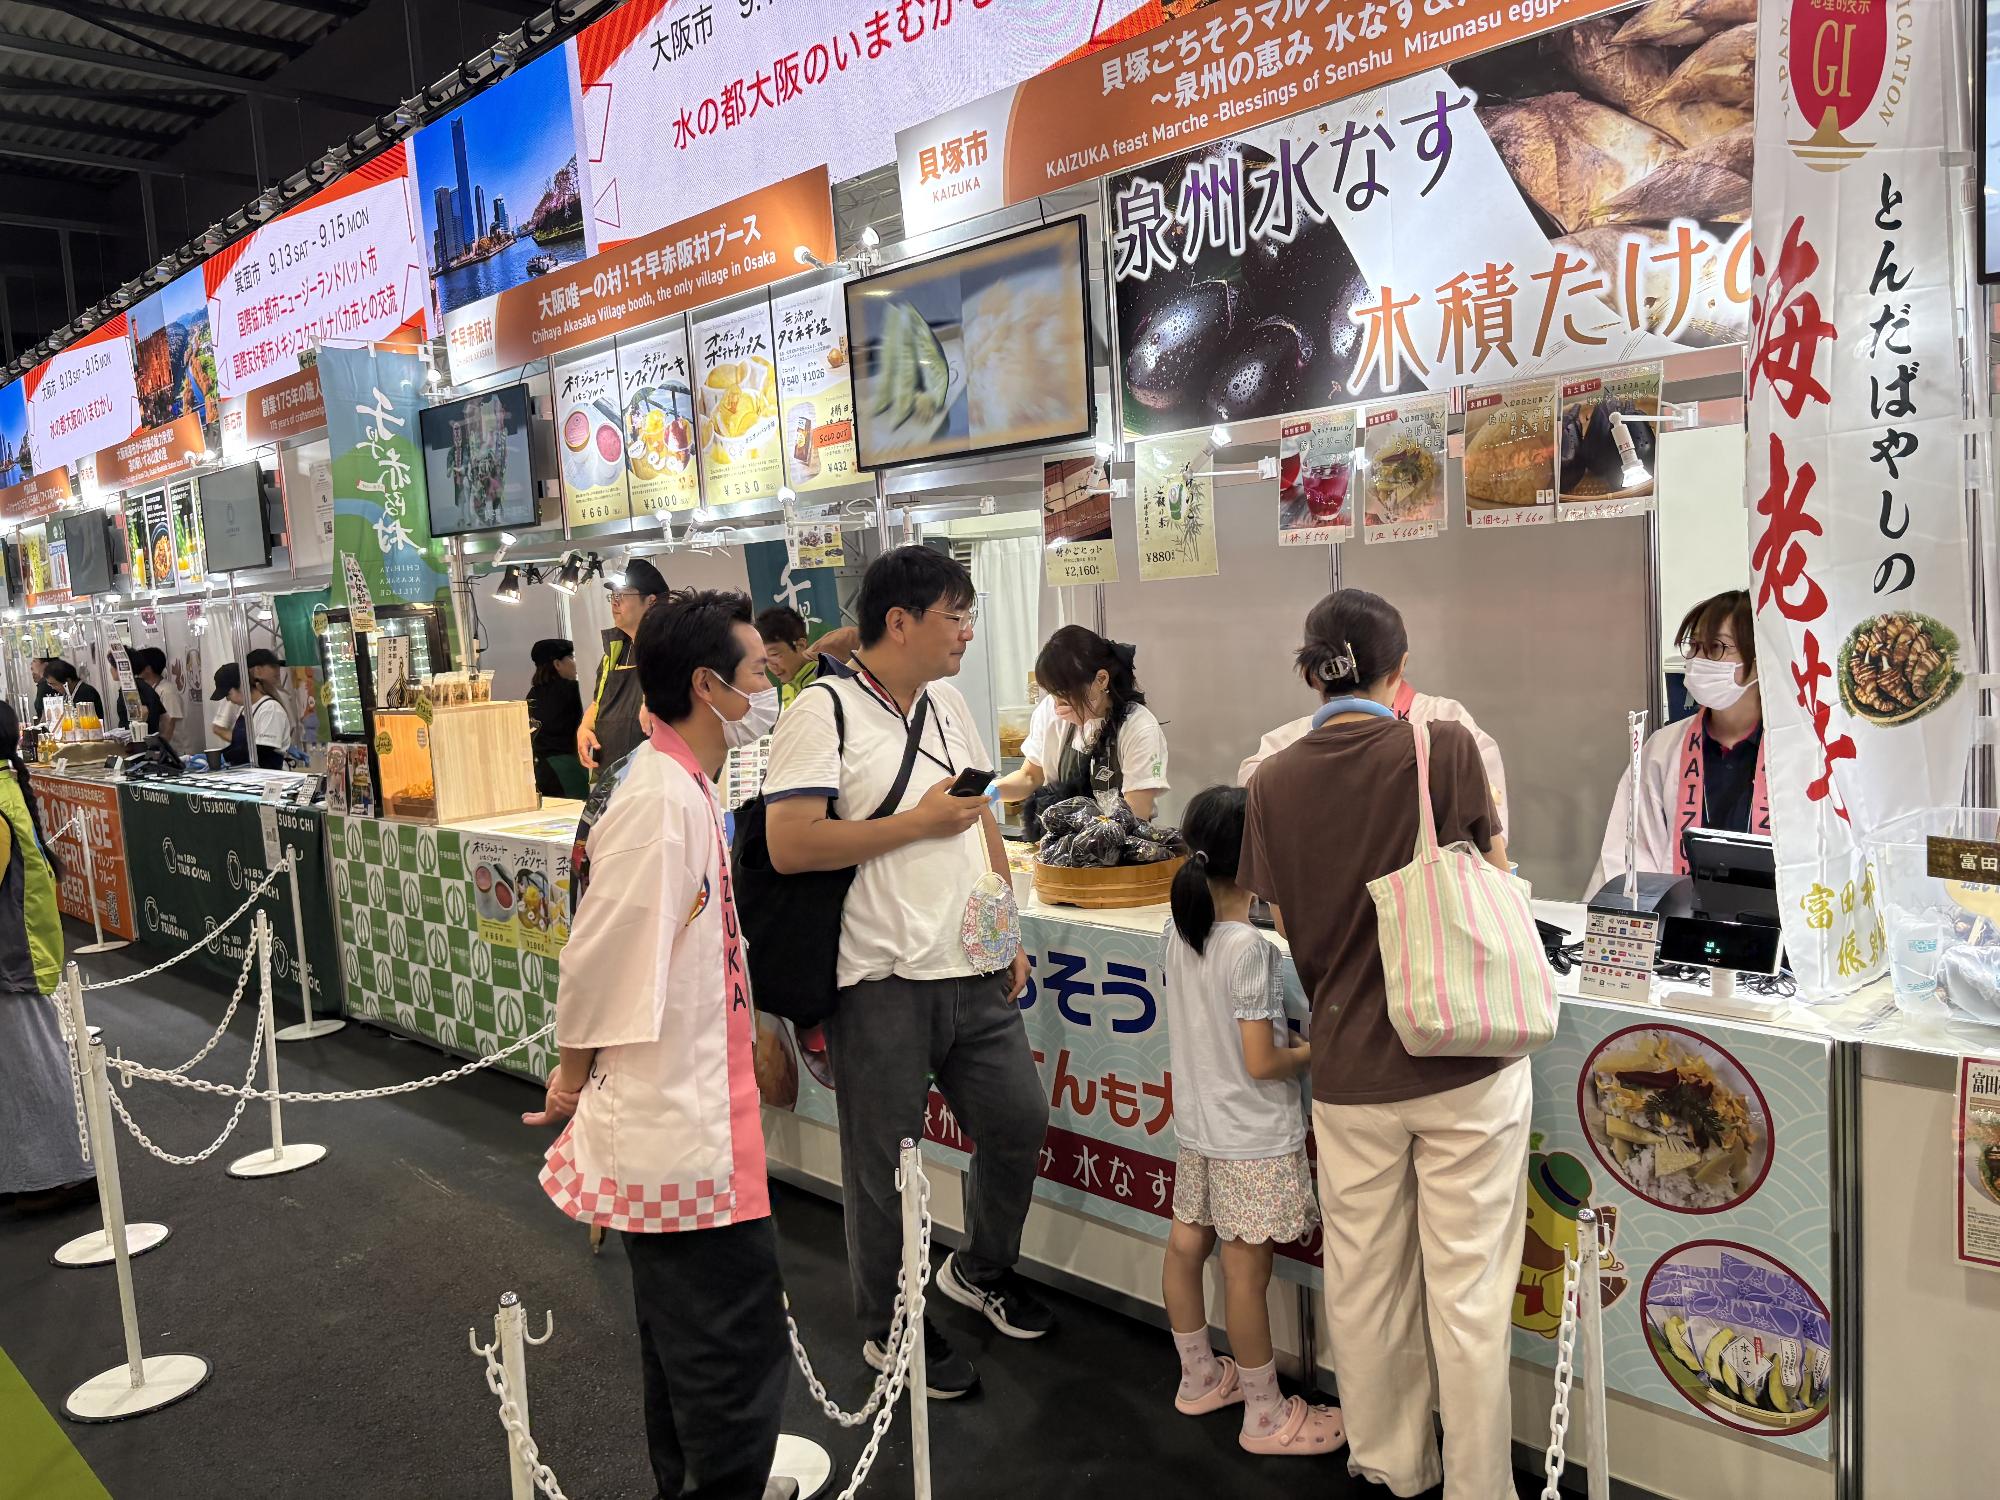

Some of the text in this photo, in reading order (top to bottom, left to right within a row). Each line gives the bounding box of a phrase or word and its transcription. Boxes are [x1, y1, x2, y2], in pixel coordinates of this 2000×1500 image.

[651, 4, 712, 71] 大阪市
[671, 0, 993, 150] 水の都大阪のいまむか
[1812, 19, 1857, 97] GI
[1046, 149, 1110, 179] KAIZUKA
[1112, 131, 1149, 156] feast
[1152, 115, 1209, 143] Marche
[1303, 70, 1320, 92] of
[1324, 48, 1394, 86] Senshu
[1404, 10, 1503, 58] Mizunasu
[919, 129, 988, 185] 貝塚市
[932, 176, 981, 203] KAIZUKA
[1117, 91, 1472, 277] 泉州水なす
[234, 261, 261, 296] 箕面市
[268, 243, 292, 275] 9.13
[294, 241, 308, 262] SAT
[319, 214, 345, 248] 9.15
[347, 207, 369, 234] MON
[237, 244, 378, 337] 国際協力都市ニュージーランドハット市
[532, 249, 777, 345] Chihaya Akasaka Village booth, the only village in Osaka
[450, 316, 493, 353] 千早赤阪村
[704, 334, 767, 369] ポテトチップス
[778, 317, 831, 350] タマネギ塩
[60, 369, 73, 390] 9.13
[85, 353, 100, 378] 9.15
[782, 368, 825, 388] ¥540 ¥1026
[1869, 173, 1920, 596] とんだばやしの
[828, 461, 848, 473] ¥432
[582, 505, 610, 520] ¥660
[644, 494, 677, 510] ¥1000
[1515, 512, 1544, 524] ¥660
[1065, 565, 1096, 578] ¥2,160
[1146, 551, 1171, 562] ¥880
[1972, 1072, 2000, 1095] 富田
[1072, 1144, 1173, 1210] 水なす
